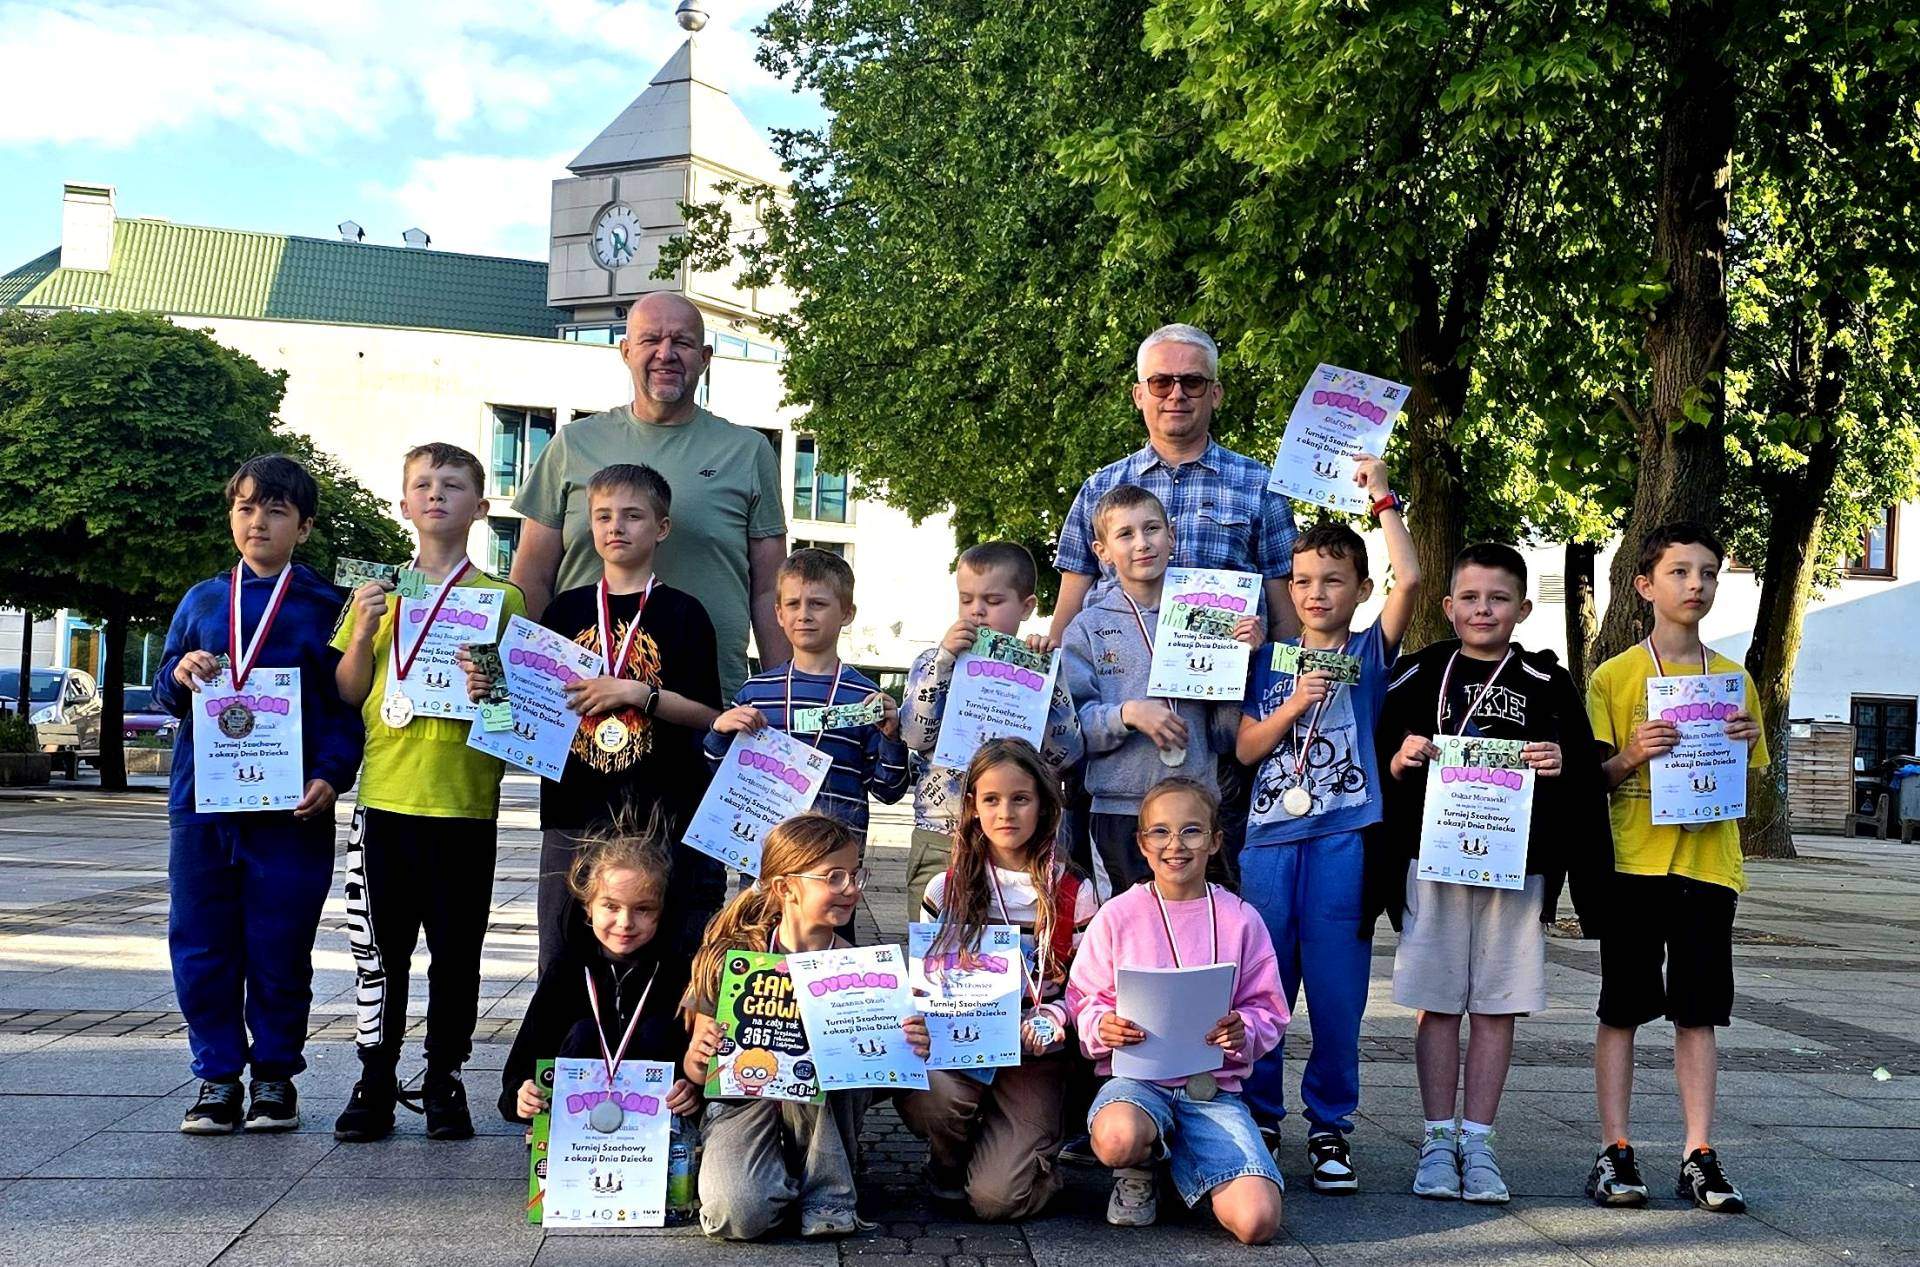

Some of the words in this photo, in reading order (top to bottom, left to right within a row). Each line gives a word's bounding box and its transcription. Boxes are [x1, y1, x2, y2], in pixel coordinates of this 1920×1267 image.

[1313, 390, 1388, 425] DYPLOM
[1302, 438, 1323, 450] okazji
[1324, 444, 1339, 455] Dnia
[1305, 427, 1328, 442] Turniej
[1329, 435, 1363, 451] Szachowy
[410, 608, 488, 630] DPLOM
[1174, 632, 1196, 640] Turniej
[1173, 642, 1194, 650] okazji
[967, 661, 1044, 692] DYPLOM
[523, 704, 538, 717] Dnia
[539, 712, 565, 727] Dziecka
[527, 699, 562, 716] Szachowy
[965, 700, 989, 712] Turniej
[990, 706, 1027, 720] Szachowy
[964, 711, 986, 722] okazji
[986, 716, 1003, 725] Dnia
[1005, 720, 1032, 731] Dziecka
[1670, 750, 1696, 759] Turniej
[1698, 750, 1730, 758] Szachowy
[739, 750, 811, 794] DYPLOM
[1441, 767, 1523, 790] DYPLOM
[725, 798, 746, 815] okazji
[746, 807, 761, 820] Dnia
[729, 787, 750, 805] Turniej
[752, 798, 785, 820] Szachowy
[1444, 809, 1469, 820] Turniej
[1471, 812, 1510, 823] Szachowy
[1443, 819, 1466, 828] okazji
[1487, 824, 1515, 832] Dziecka
[808, 972, 898, 997] DYPLOM
[959, 1000, 999, 1008] Szachowy
[766, 1019, 783, 1029] cały
[786, 1020, 799, 1029] rok
[826, 1018, 854, 1027] Turniej
[857, 1015, 897, 1023] Szachowy
[742, 1027, 771, 1046] 365
[830, 1027, 854, 1035] okazji
[572, 1143, 600, 1153] Turniej
[602, 1144, 646, 1153] Szachowy
[572, 1155, 597, 1164] okazji
